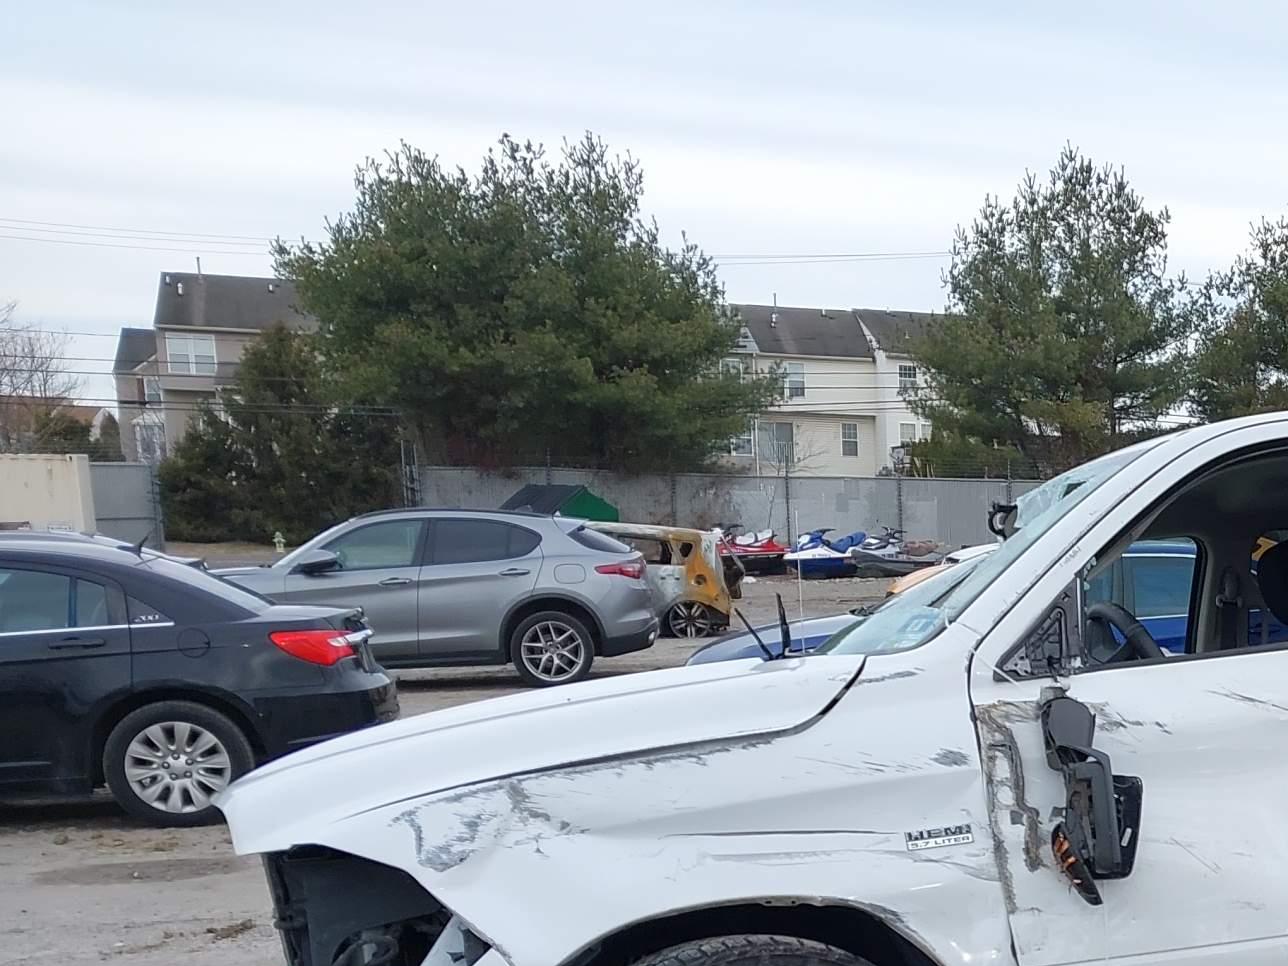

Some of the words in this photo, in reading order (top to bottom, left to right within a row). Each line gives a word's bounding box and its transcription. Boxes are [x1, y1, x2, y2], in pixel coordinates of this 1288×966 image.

[906, 824, 972, 841] HEMI
[911, 841, 930, 849] 5.7
[934, 836, 970, 846] LITER
